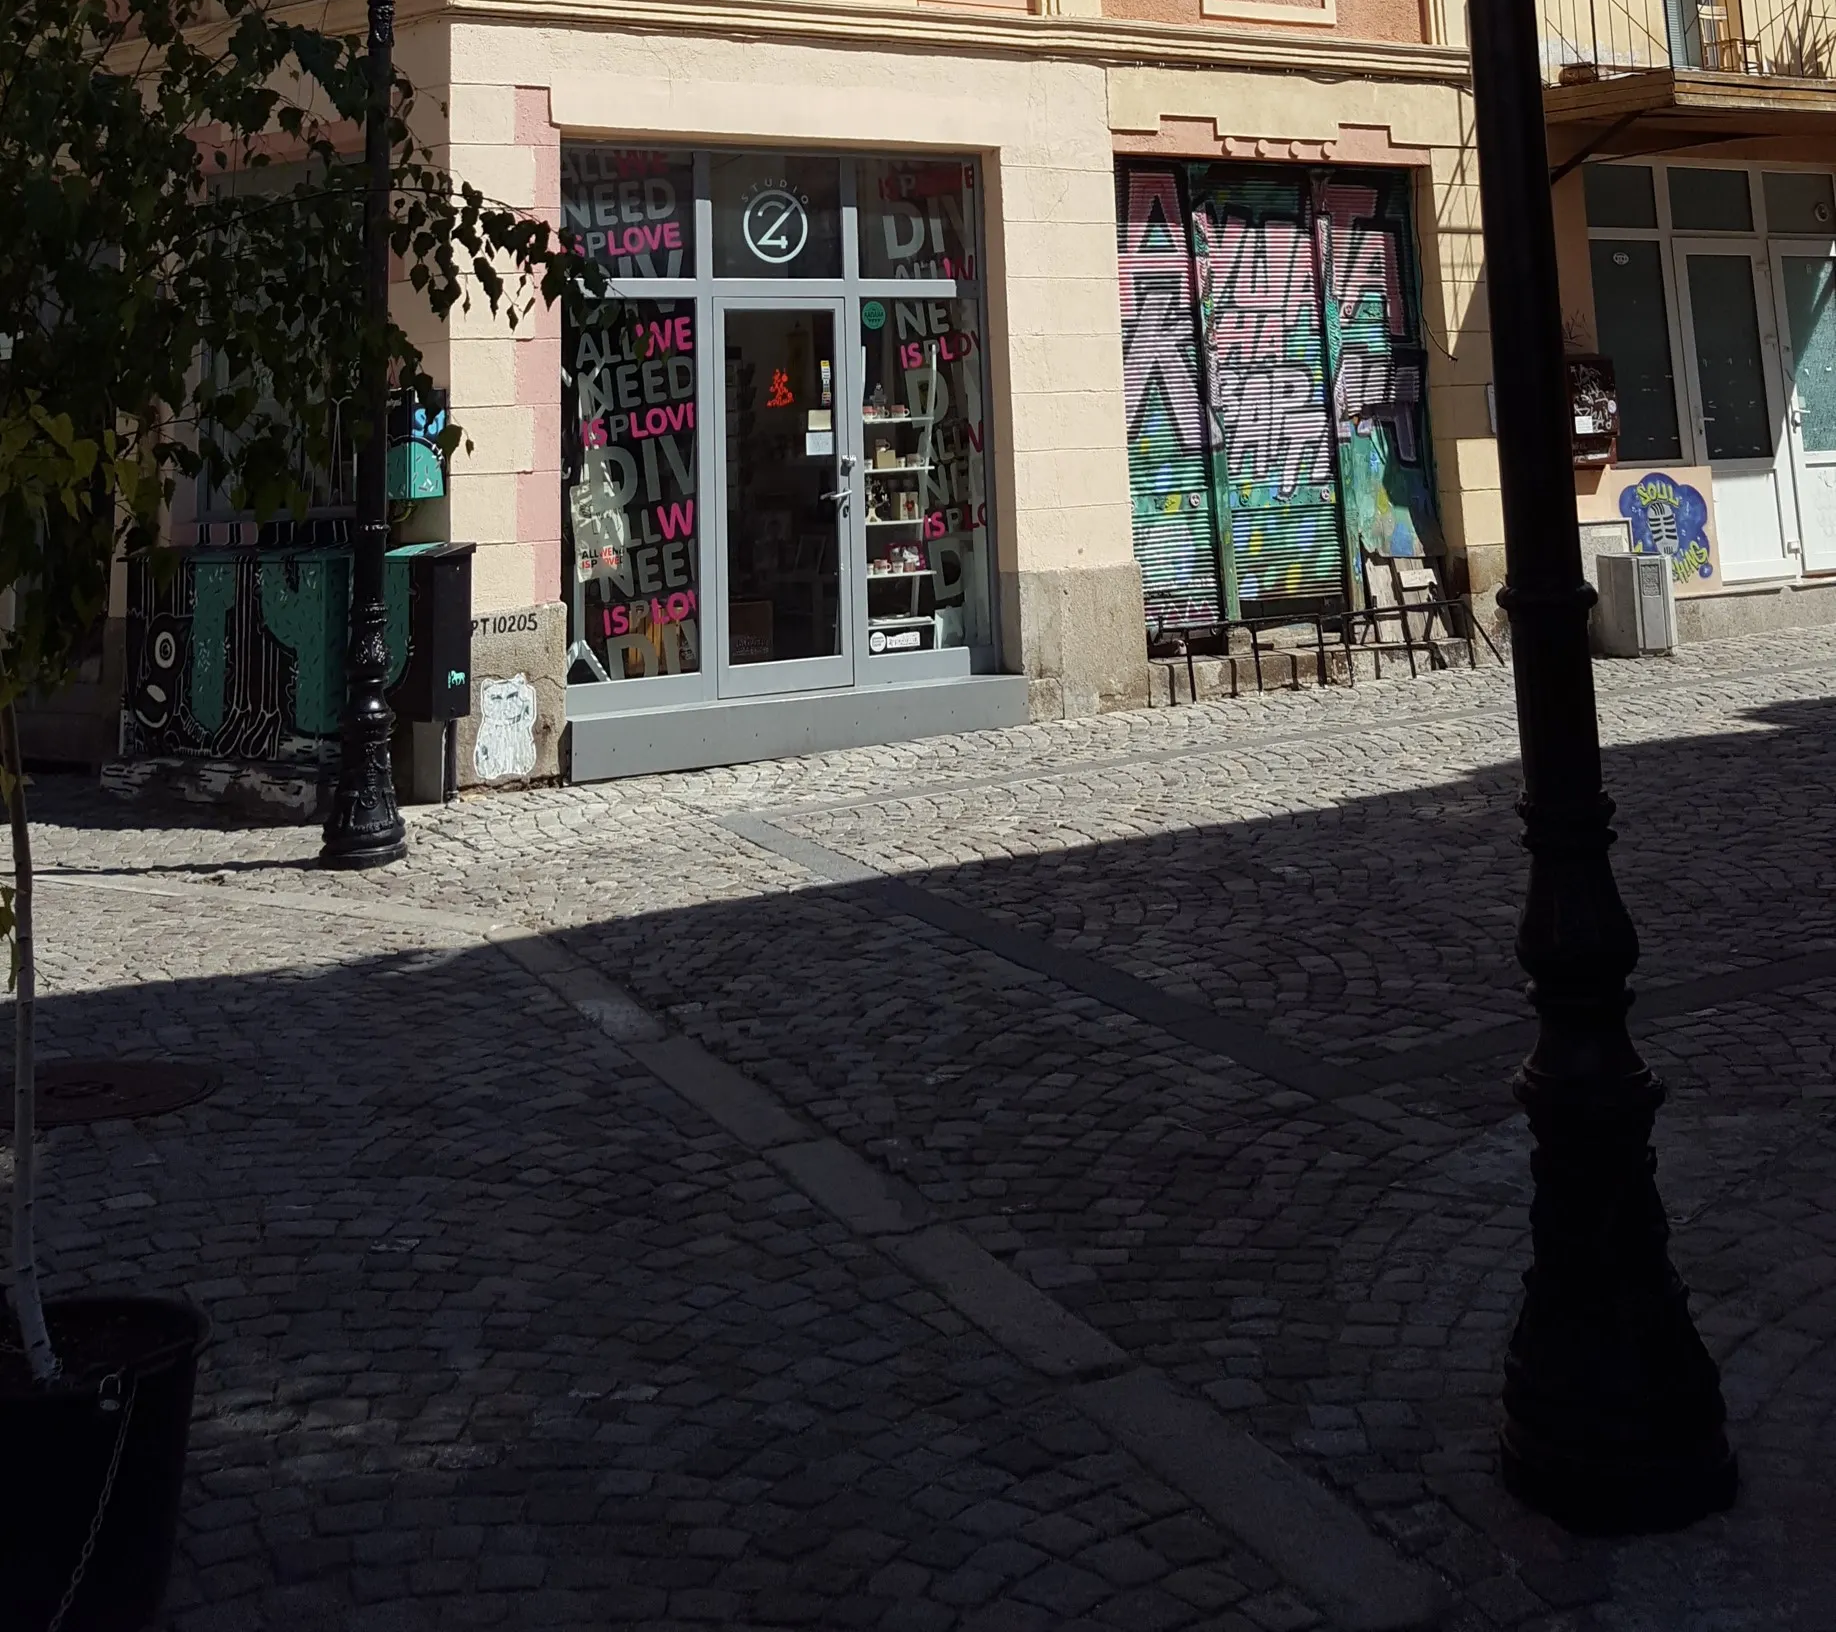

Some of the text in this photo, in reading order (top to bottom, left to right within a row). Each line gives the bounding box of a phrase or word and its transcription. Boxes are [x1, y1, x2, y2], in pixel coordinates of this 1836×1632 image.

[560, 177, 676, 229] NEED
[741, 178, 809, 204] STUDIO
[577, 355, 694, 411] NEED
[1636, 479, 1680, 507] SOUL
[599, 538, 696, 603] NEE
